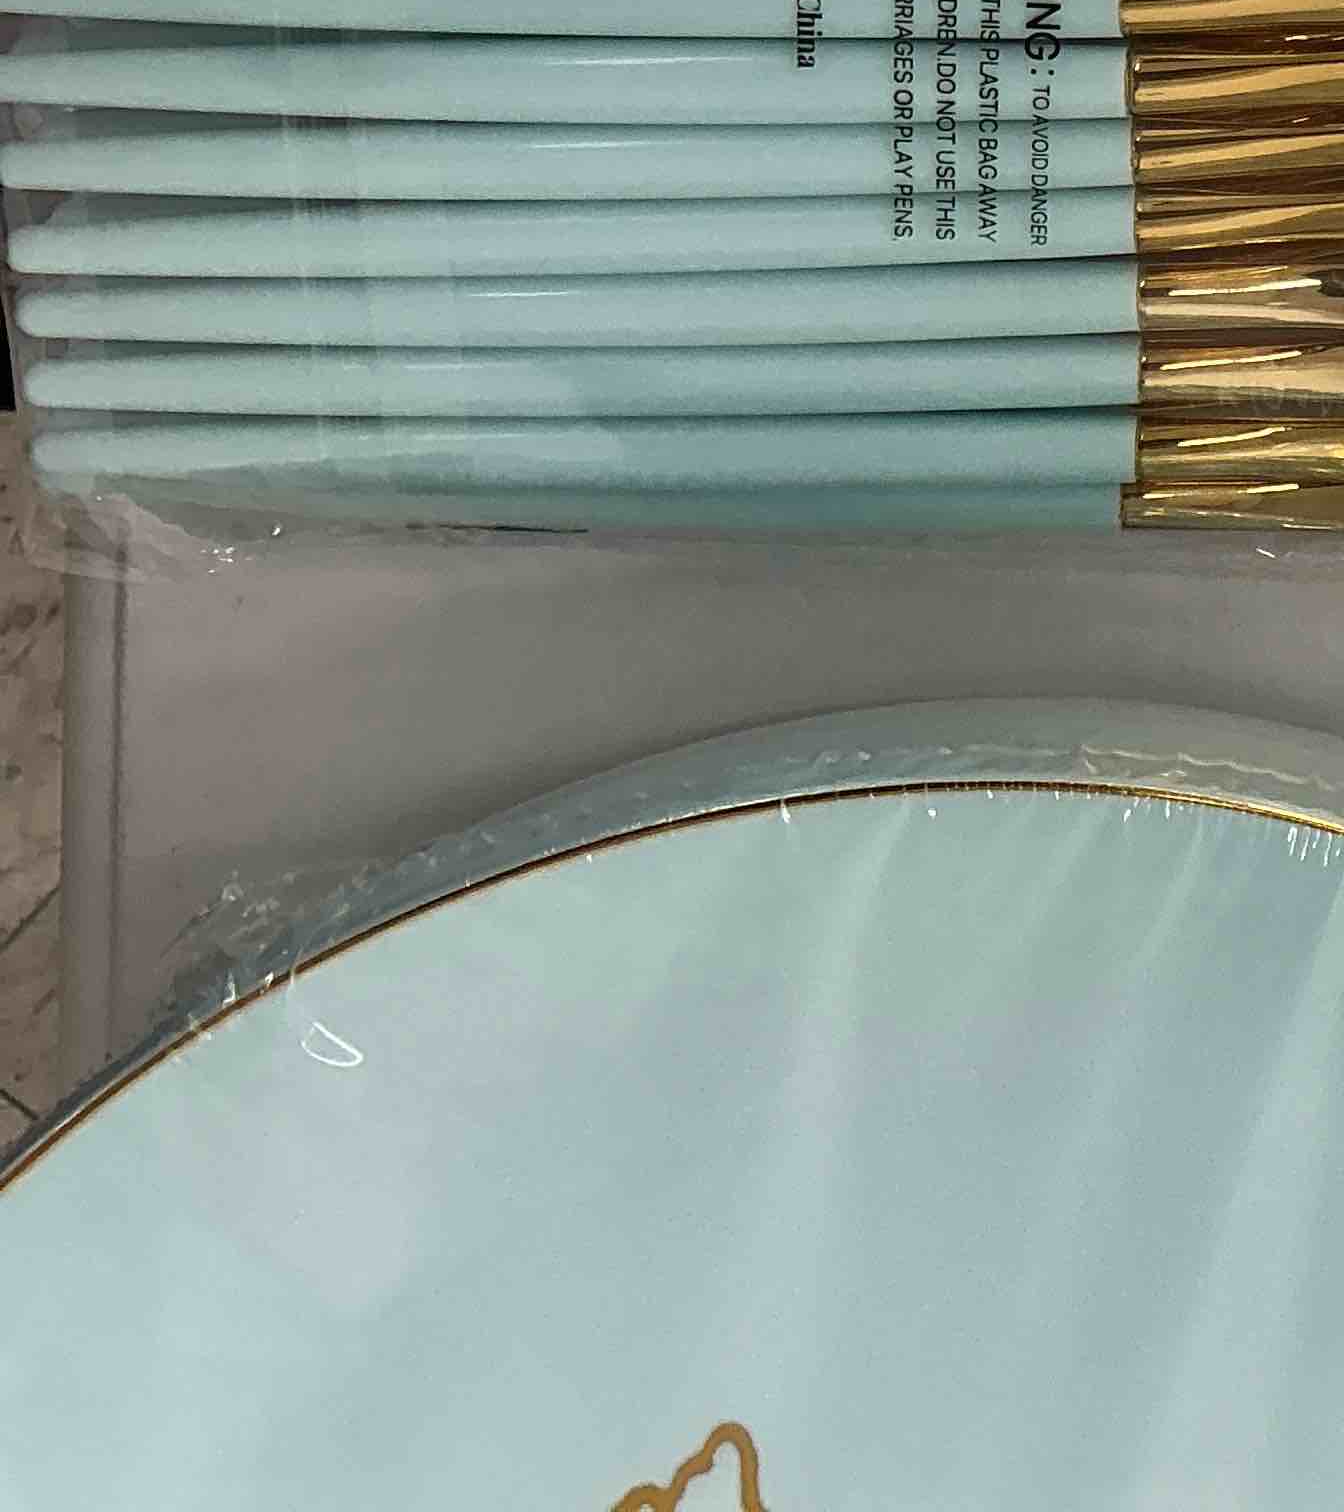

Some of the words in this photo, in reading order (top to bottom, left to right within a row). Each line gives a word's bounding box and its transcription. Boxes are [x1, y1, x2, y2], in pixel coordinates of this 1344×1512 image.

[894, 90, 913, 119] OR
[979, 48, 999, 133] PLASTIC
[1033, 86, 1050, 110] TO
[936, 100, 955, 145] NOT
[1032, 115, 1049, 169] AVOID
[894, 126, 913, 178] PLAY
[936, 151, 955, 192] USE
[979, 139, 998, 178] BAG
[936, 196, 955, 240] THIS
[979, 184, 997, 243] AWAY
[1030, 174, 1048, 245] DANGER
